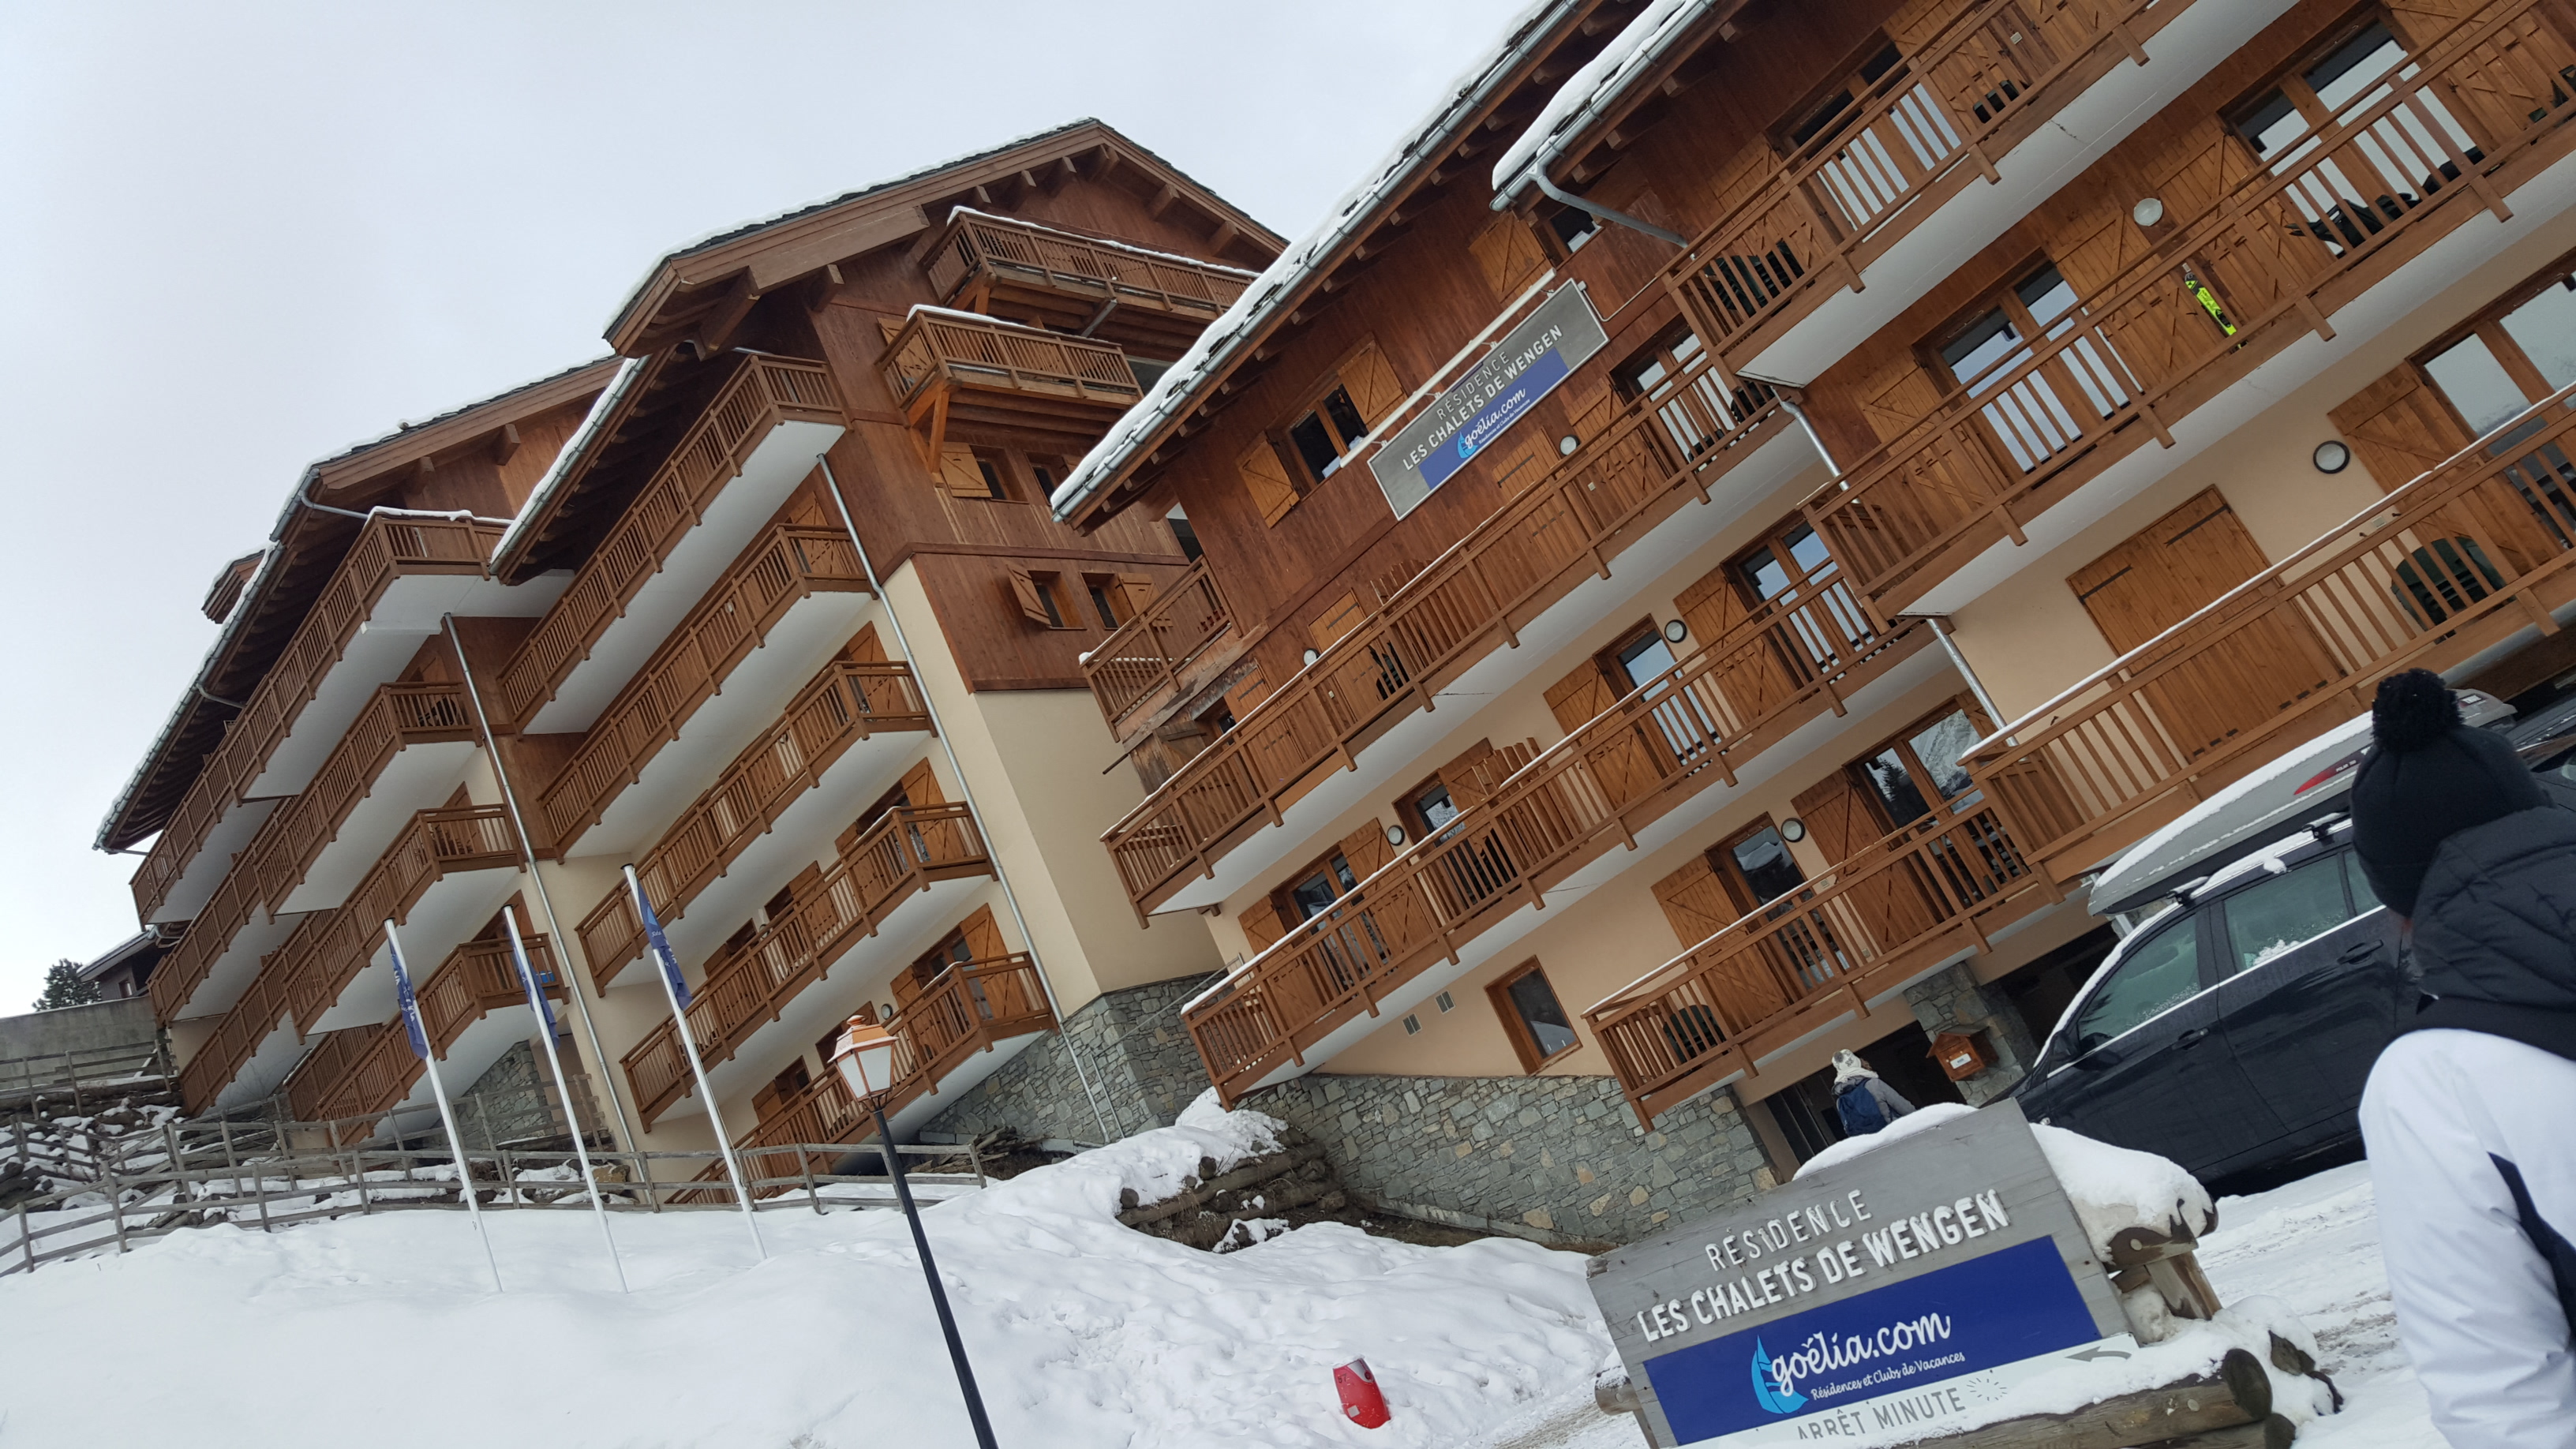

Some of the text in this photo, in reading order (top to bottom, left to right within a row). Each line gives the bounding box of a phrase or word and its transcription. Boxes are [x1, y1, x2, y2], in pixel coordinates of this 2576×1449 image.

[1402, 324, 1563, 470] LES CHALETS DE WENGEN
[1436, 351, 1510, 420] RÉSIDENCE
[1637, 1189, 2010, 1342] LES CHALETS DE WENGEN
[1810, 1352, 1965, 1400] Résidences et Clubs de Vacances
[1797, 1387, 1966, 1440] ARRÊT MINUTE
